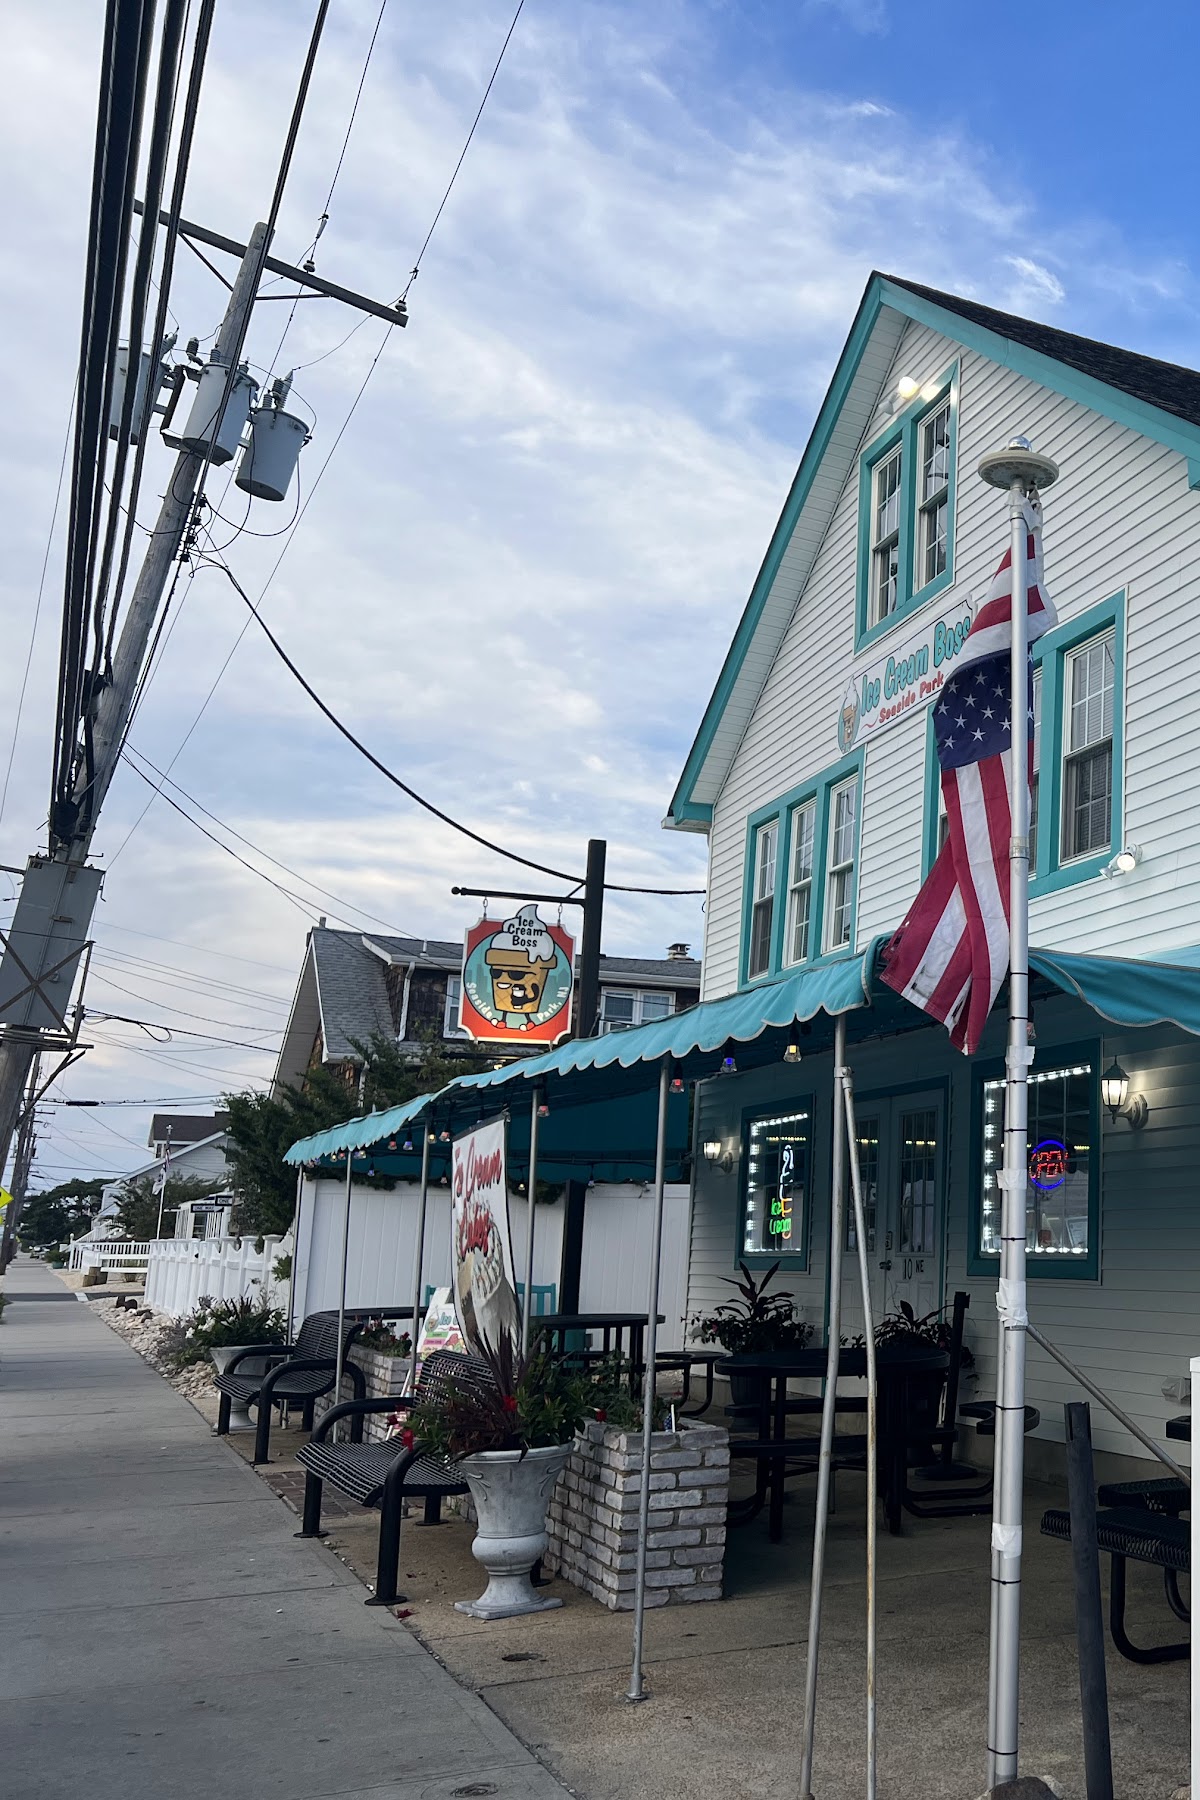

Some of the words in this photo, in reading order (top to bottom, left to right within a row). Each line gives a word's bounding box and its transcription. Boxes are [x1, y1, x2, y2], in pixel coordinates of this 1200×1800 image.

[861, 674, 880, 716] Ice
[884, 643, 929, 700] Cream
[933, 615, 971, 668] Boss
[879, 689, 916, 723] Seaside
[919, 670, 944, 698] Park
[507, 922, 543, 936] Cream
[518, 915, 534, 927] Ice
[512, 934, 538, 948] Boss
[466, 981, 493, 1019] Seaside
[536, 1001, 562, 1022] Park,
[556, 986, 569, 998] NJ
[903, 1258, 913, 1280] 10
